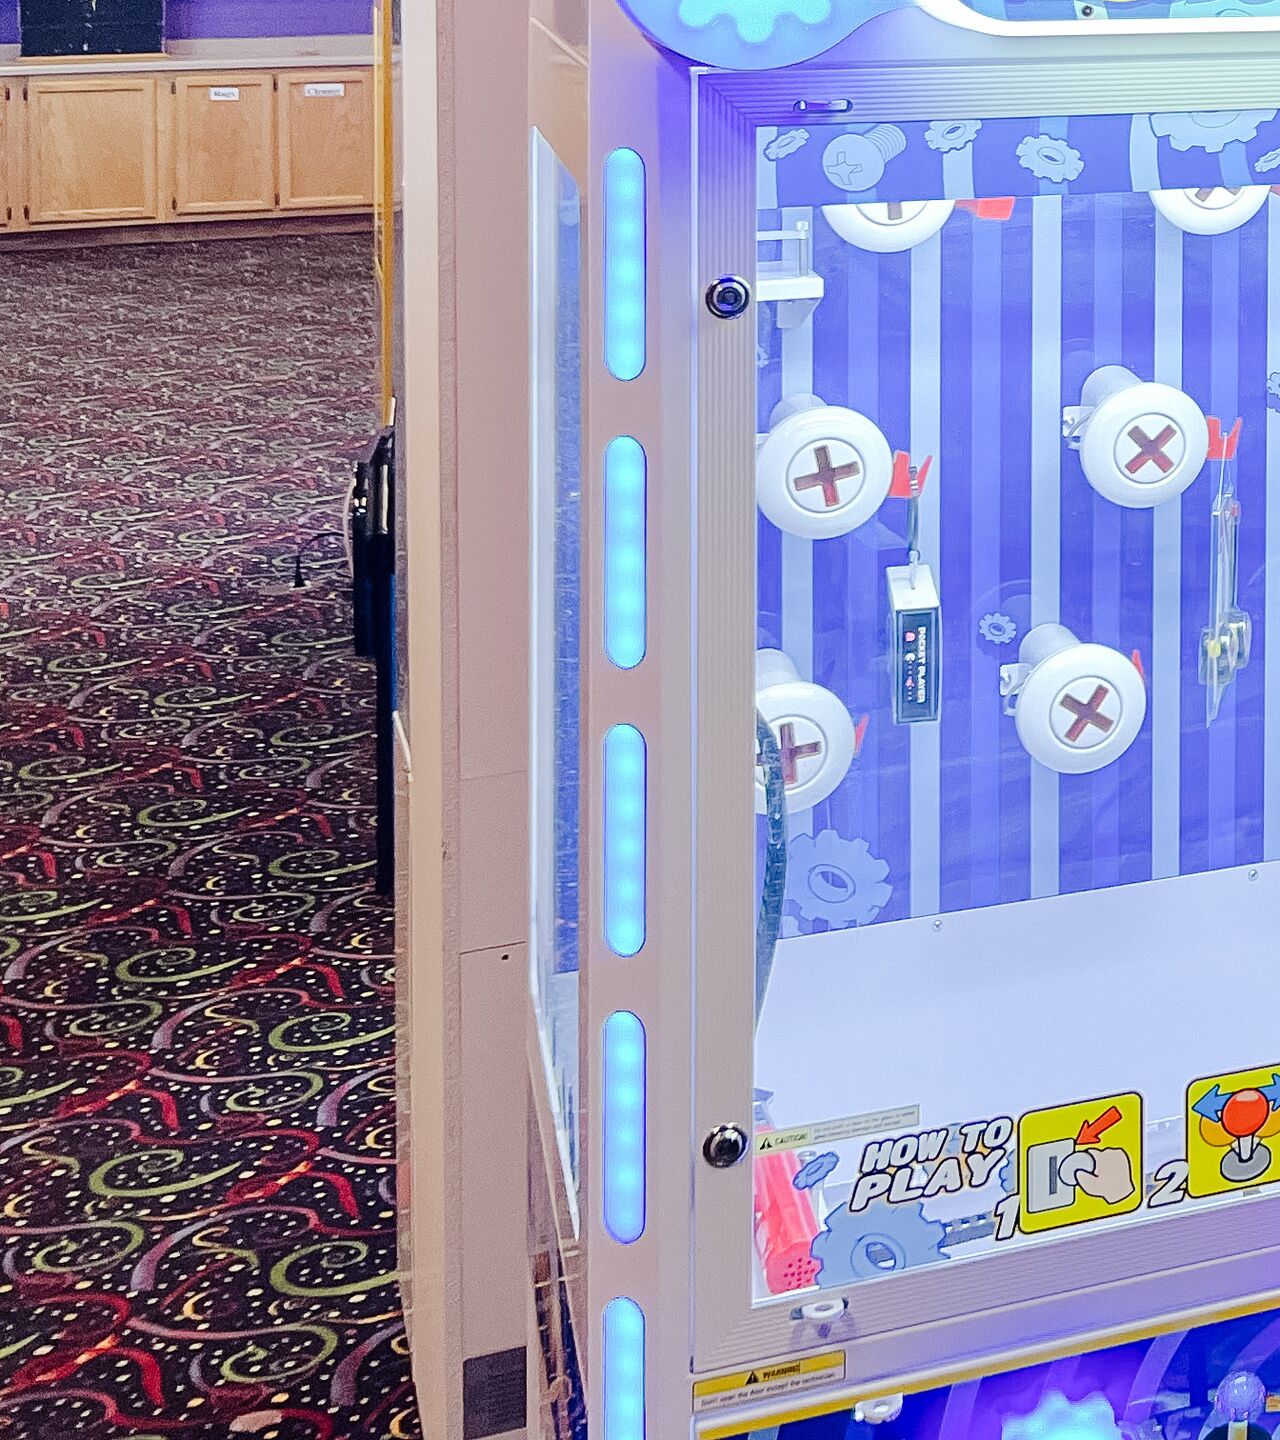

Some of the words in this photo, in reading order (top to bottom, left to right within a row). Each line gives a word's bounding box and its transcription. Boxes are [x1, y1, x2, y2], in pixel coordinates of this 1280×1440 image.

[917, 665, 927, 704] PLAYER
[859, 1128, 949, 1174] HOW
[957, 1115, 1014, 1154] TO
[849, 1148, 1006, 1213] PLAY
[1147, 1159, 1189, 1209] 2
[994, 1192, 1020, 1242] 1
